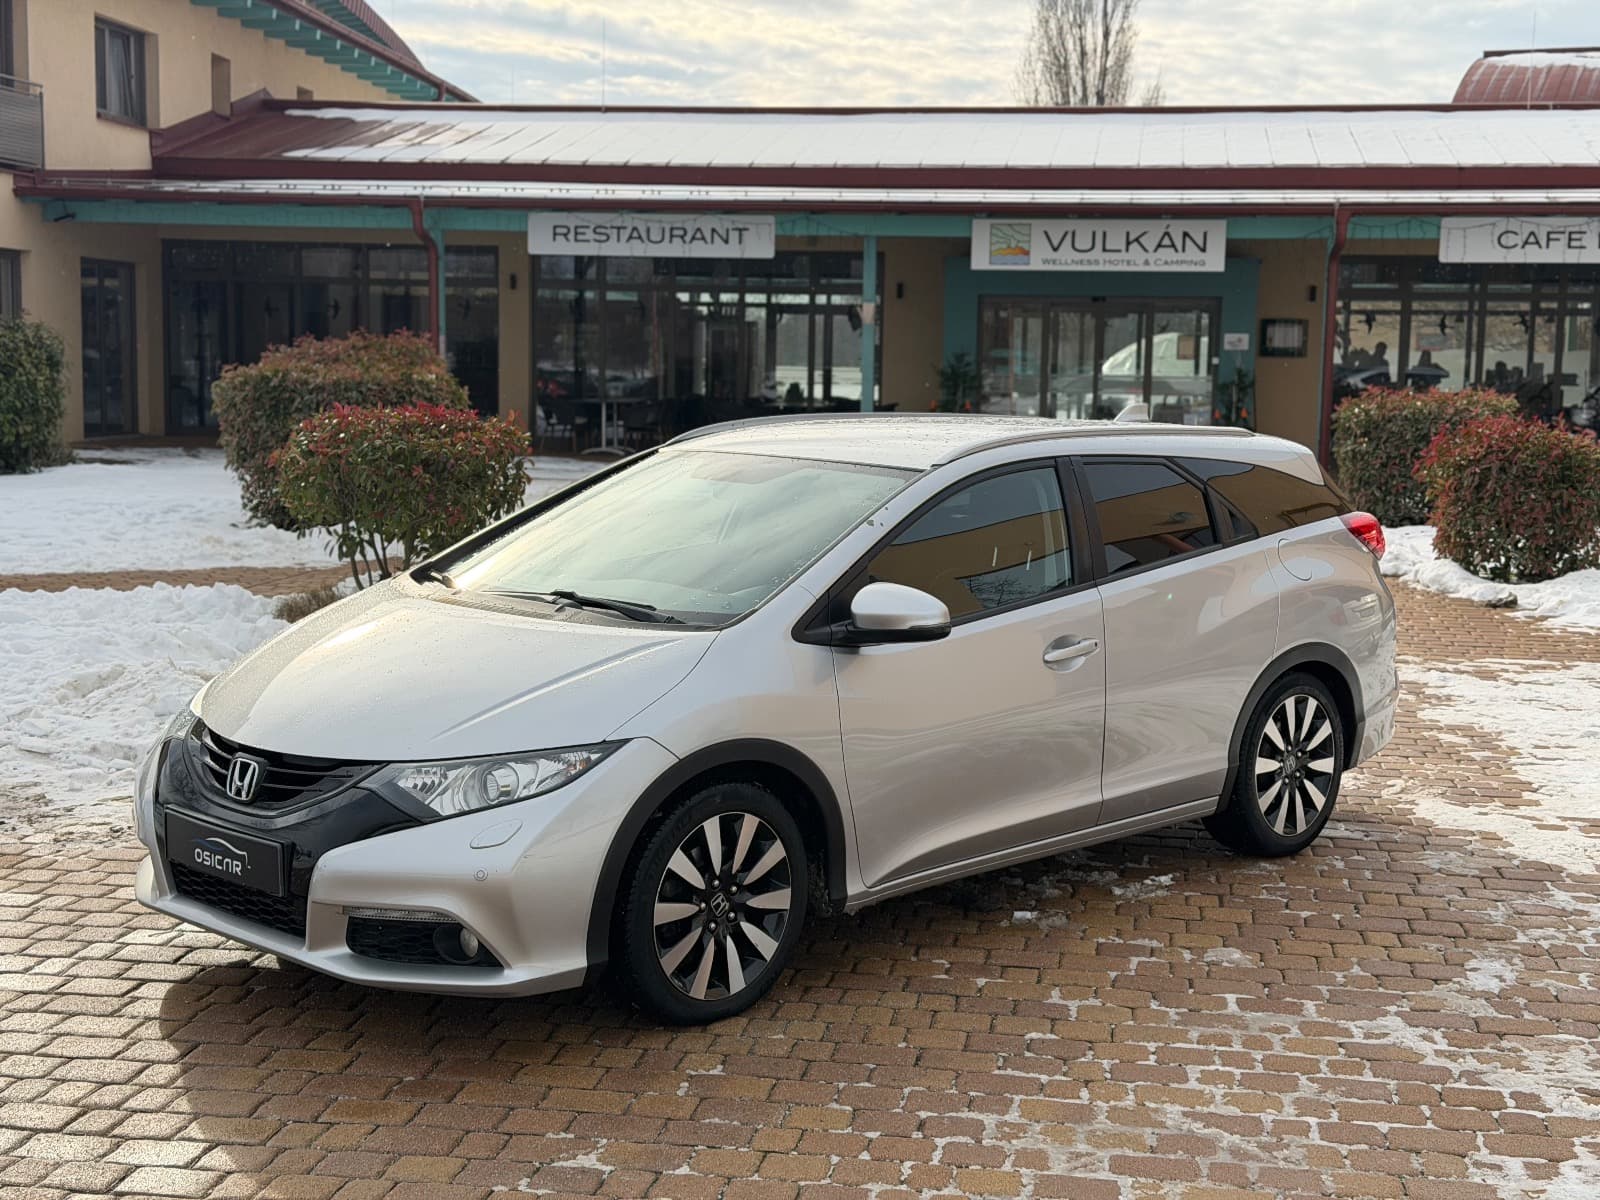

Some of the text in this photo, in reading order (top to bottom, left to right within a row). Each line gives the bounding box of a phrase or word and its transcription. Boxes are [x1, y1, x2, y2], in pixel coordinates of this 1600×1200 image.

[552, 224, 750, 245] RESTAURANT
[1043, 224, 1208, 253] VULKÁN
[1497, 230, 1587, 249] CAFE
[1041, 257, 1099, 266] WELLNESS
[1103, 258, 1139, 267] HOTEL
[1154, 258, 1207, 267] CAMPING
[194, 848, 242, 875] OSICAR
